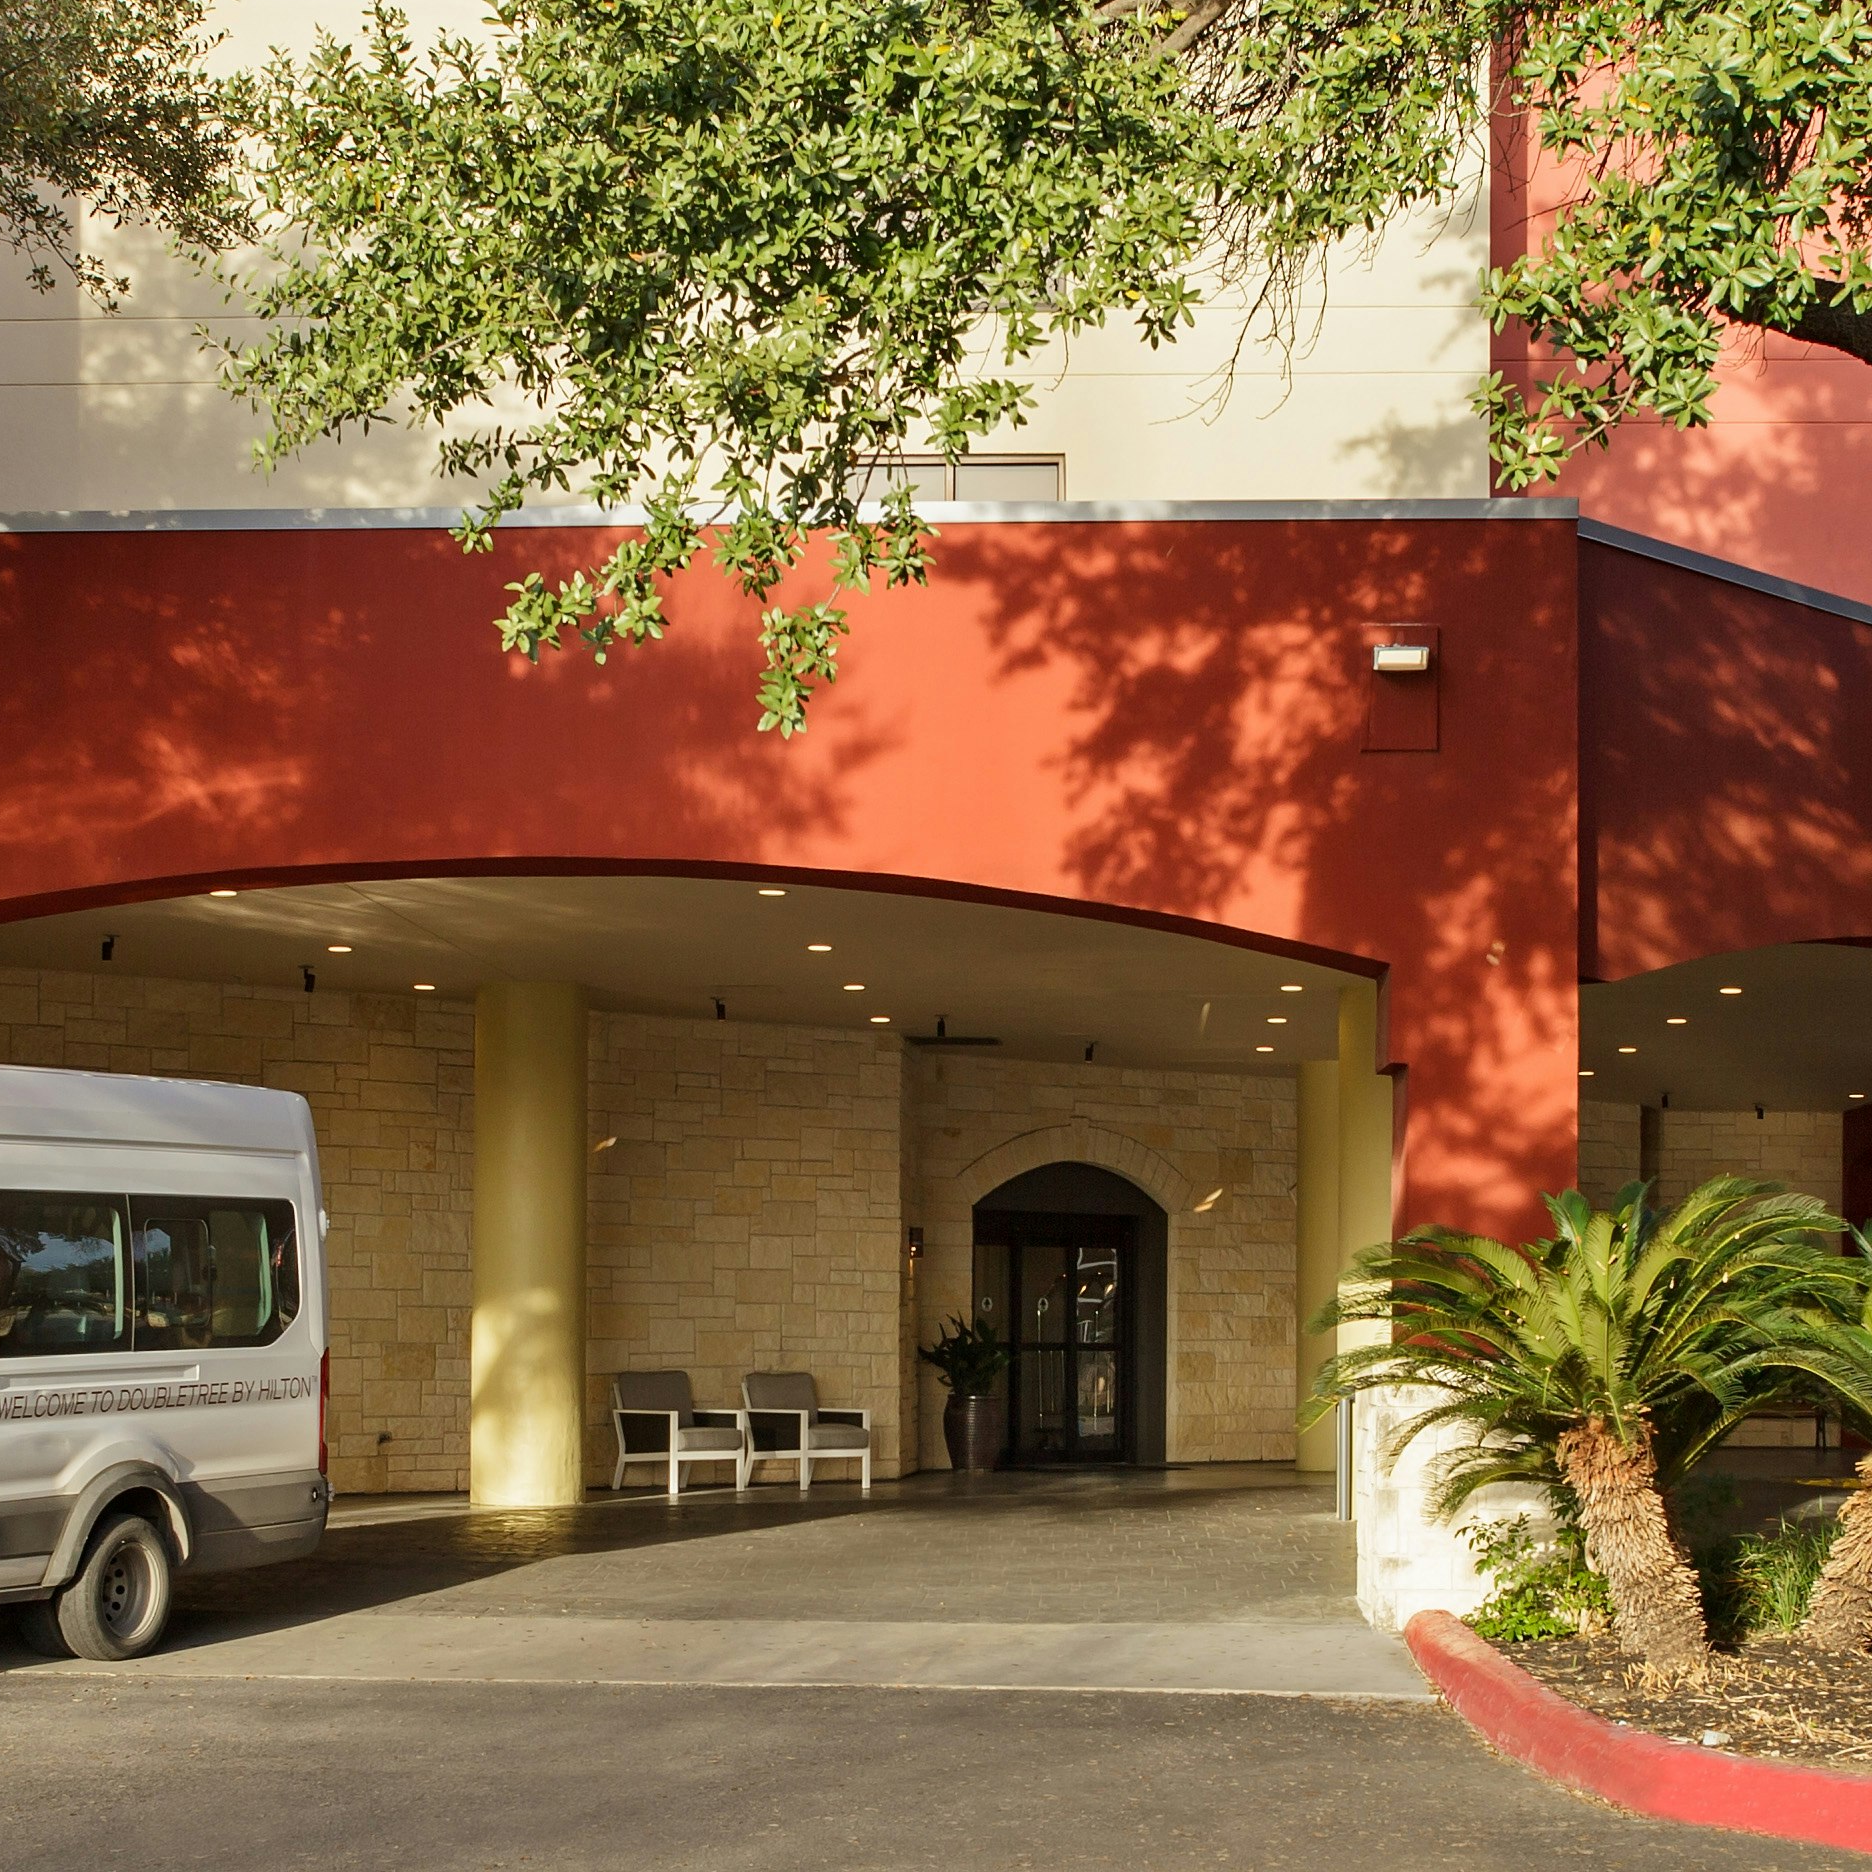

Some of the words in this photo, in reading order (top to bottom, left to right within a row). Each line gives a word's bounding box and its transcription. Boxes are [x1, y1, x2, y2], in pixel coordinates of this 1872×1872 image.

[91, 1390, 114, 1413] TO
[117, 1382, 229, 1411] DOUBLETREE
[232, 1380, 255, 1403] BY
